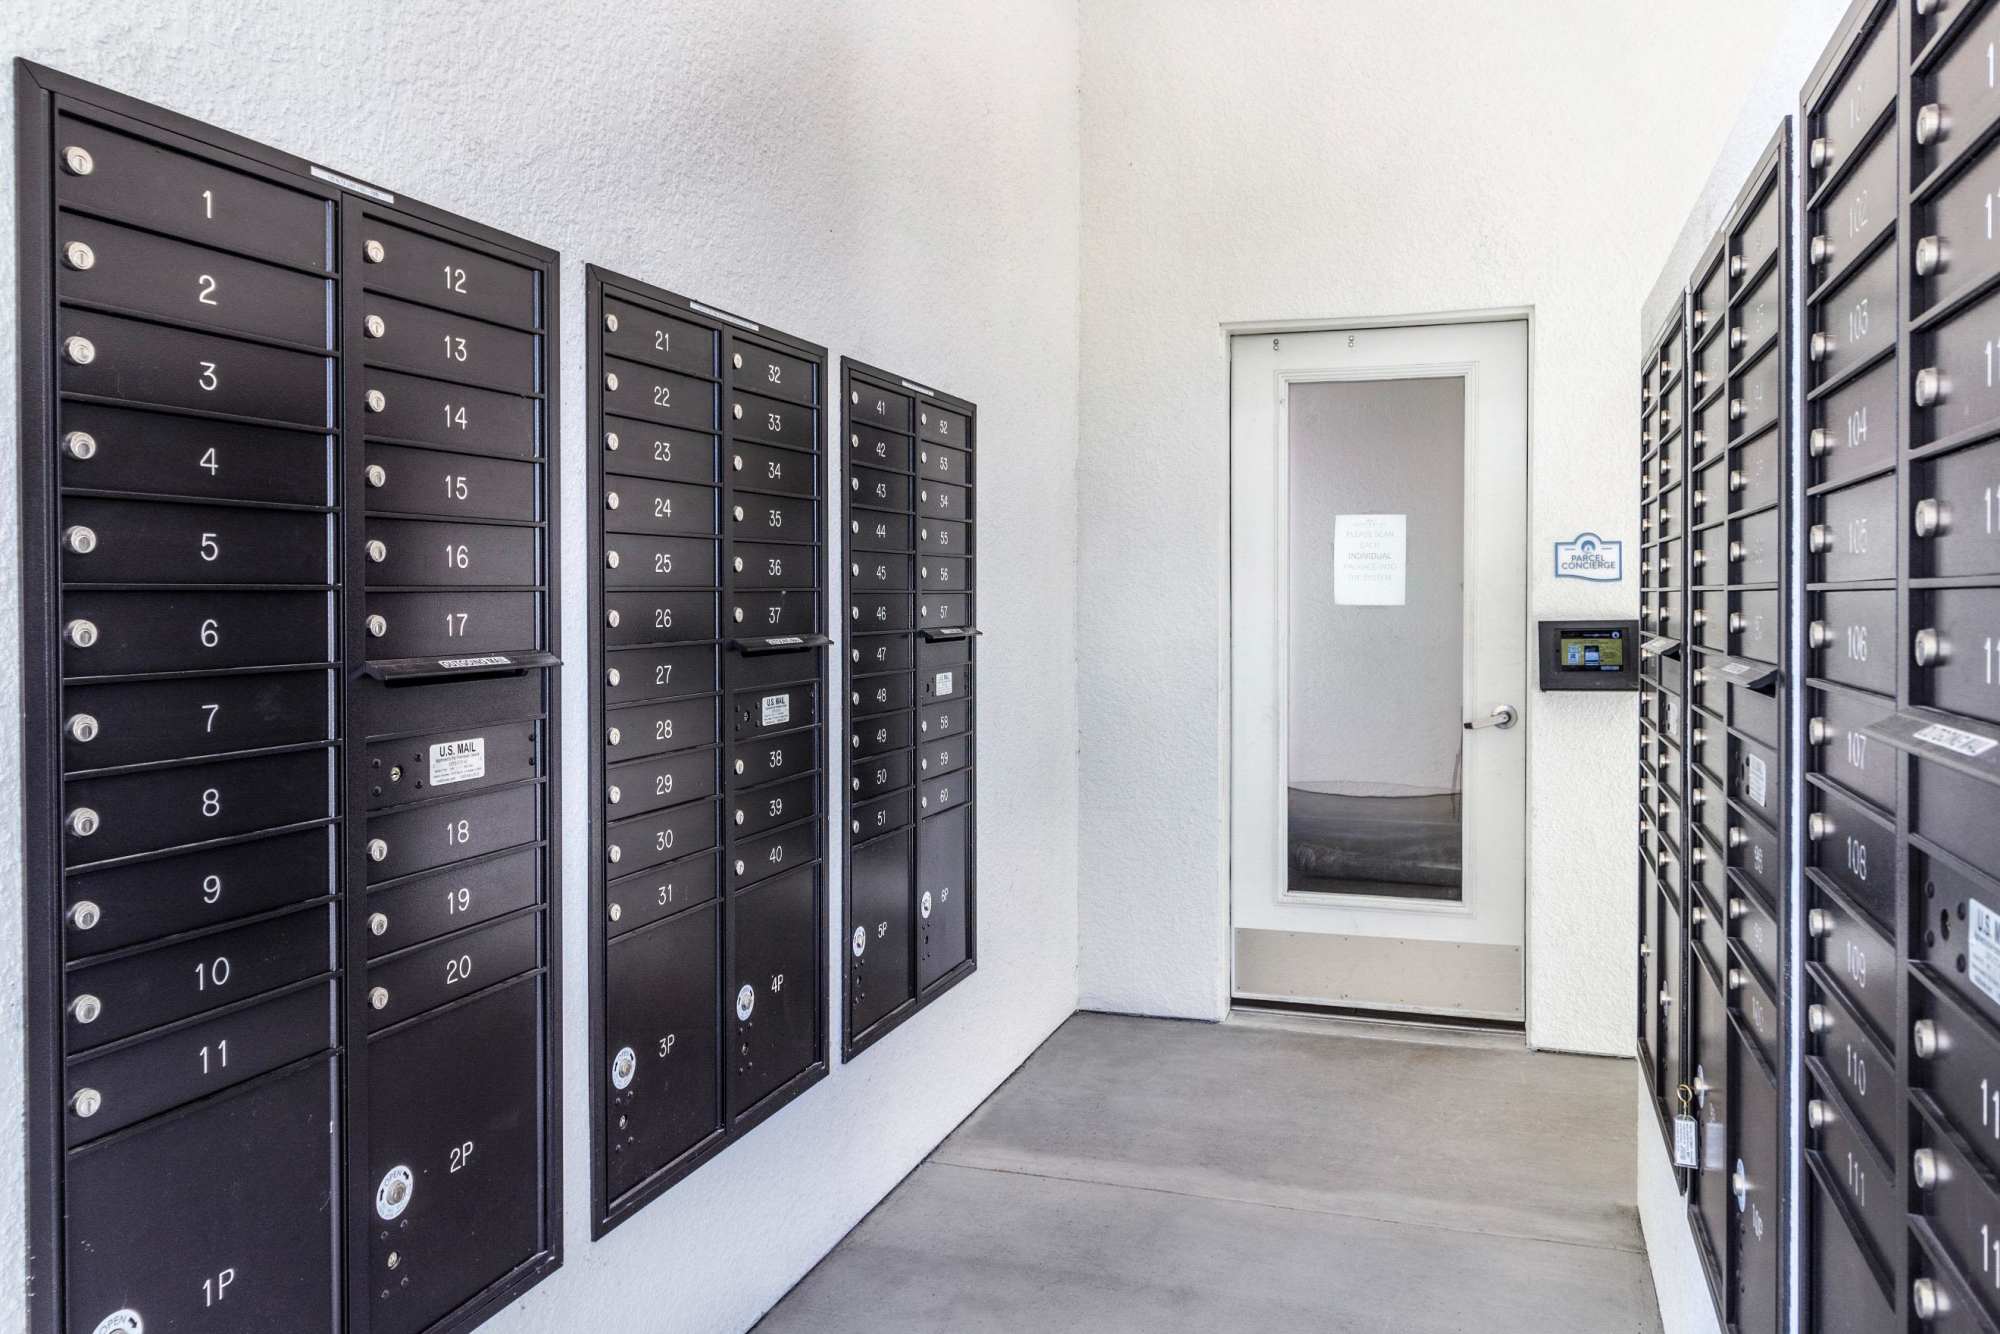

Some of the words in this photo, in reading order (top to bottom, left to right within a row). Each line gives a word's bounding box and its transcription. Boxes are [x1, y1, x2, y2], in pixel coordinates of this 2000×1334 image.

[202, 190, 212, 219] 1
[198, 274, 218, 306] 2
[444, 265, 467, 294] 12
[1849, 297, 1869, 343] 103
[444, 335, 467, 362] 13
[655, 330, 669, 352] 21
[199, 361, 218, 391] 3
[767, 364, 781, 384] 32
[654, 385, 671, 408] 22
[876, 400, 885, 415] 41
[444, 404, 468, 430] 14
[768, 413, 781, 432] 33
[1848, 405, 1868, 448] 104
[654, 440, 671, 462] 23
[876, 441, 886, 458] 42
[199, 447, 219, 476] 4
[768, 461, 782, 479] 34
[444, 475, 468, 500] 15
[876, 483, 887, 499] 43
[654, 497, 672, 518] 24
[768, 509, 782, 528] 35
[875, 523, 886, 538] 44
[200, 532, 219, 562] 5
[446, 544, 469, 569] 16
[1348, 552, 1392, 560] INDIVIDUAL
[1570, 554, 1606, 562] PARCEL
[654, 553, 672, 573] 25
[768, 559, 782, 576] 36
[876, 565, 887, 581] 45
[1560, 561, 1617, 570] CONCIERGE
[655, 608, 672, 628] 26
[768, 606, 781, 624] 37
[876, 606, 887, 621] 46
[200, 618, 219, 648] 6
[446, 613, 468, 637] 17
[876, 646, 887, 662] 47
[1847, 625, 1868, 662] 106
[656, 664, 672, 685] 27
[876, 687, 887, 703] 48
[201, 703, 219, 733] 7
[656, 719, 673, 740] 28
[876, 728, 887, 743] 49
[439, 744, 456, 758] U.S.
[457, 741, 476, 755] MAIL
[769, 749, 783, 768] 38
[1847, 730, 1867, 770] 107
[656, 773, 673, 796] 29
[876, 768, 887, 785] 50
[202, 788, 220, 817] 8
[769, 798, 783, 817] 39
[877, 809, 886, 826] 51
[447, 819, 470, 846] 18
[656, 829, 674, 851] 30
[769, 845, 783, 863] 40
[1847, 834, 1867, 881] 108
[203, 874, 221, 904] 9
[658, 883, 672, 906] 31
[447, 887, 470, 915] 19
[877, 921, 888, 939] 5P
[195, 956, 230, 991] 10
[446, 954, 472, 985] 20
[1847, 939, 1866, 989] 109
[771, 973, 784, 993] 4P
[199, 1039, 227, 1074] 11
[658, 1033, 675, 1058] 3P
[1846, 1043, 1867, 1097] 110
[449, 1140, 474, 1174] 2P
[1847, 1150, 1866, 1208] 111
[202, 1268, 235, 1307] 1P
